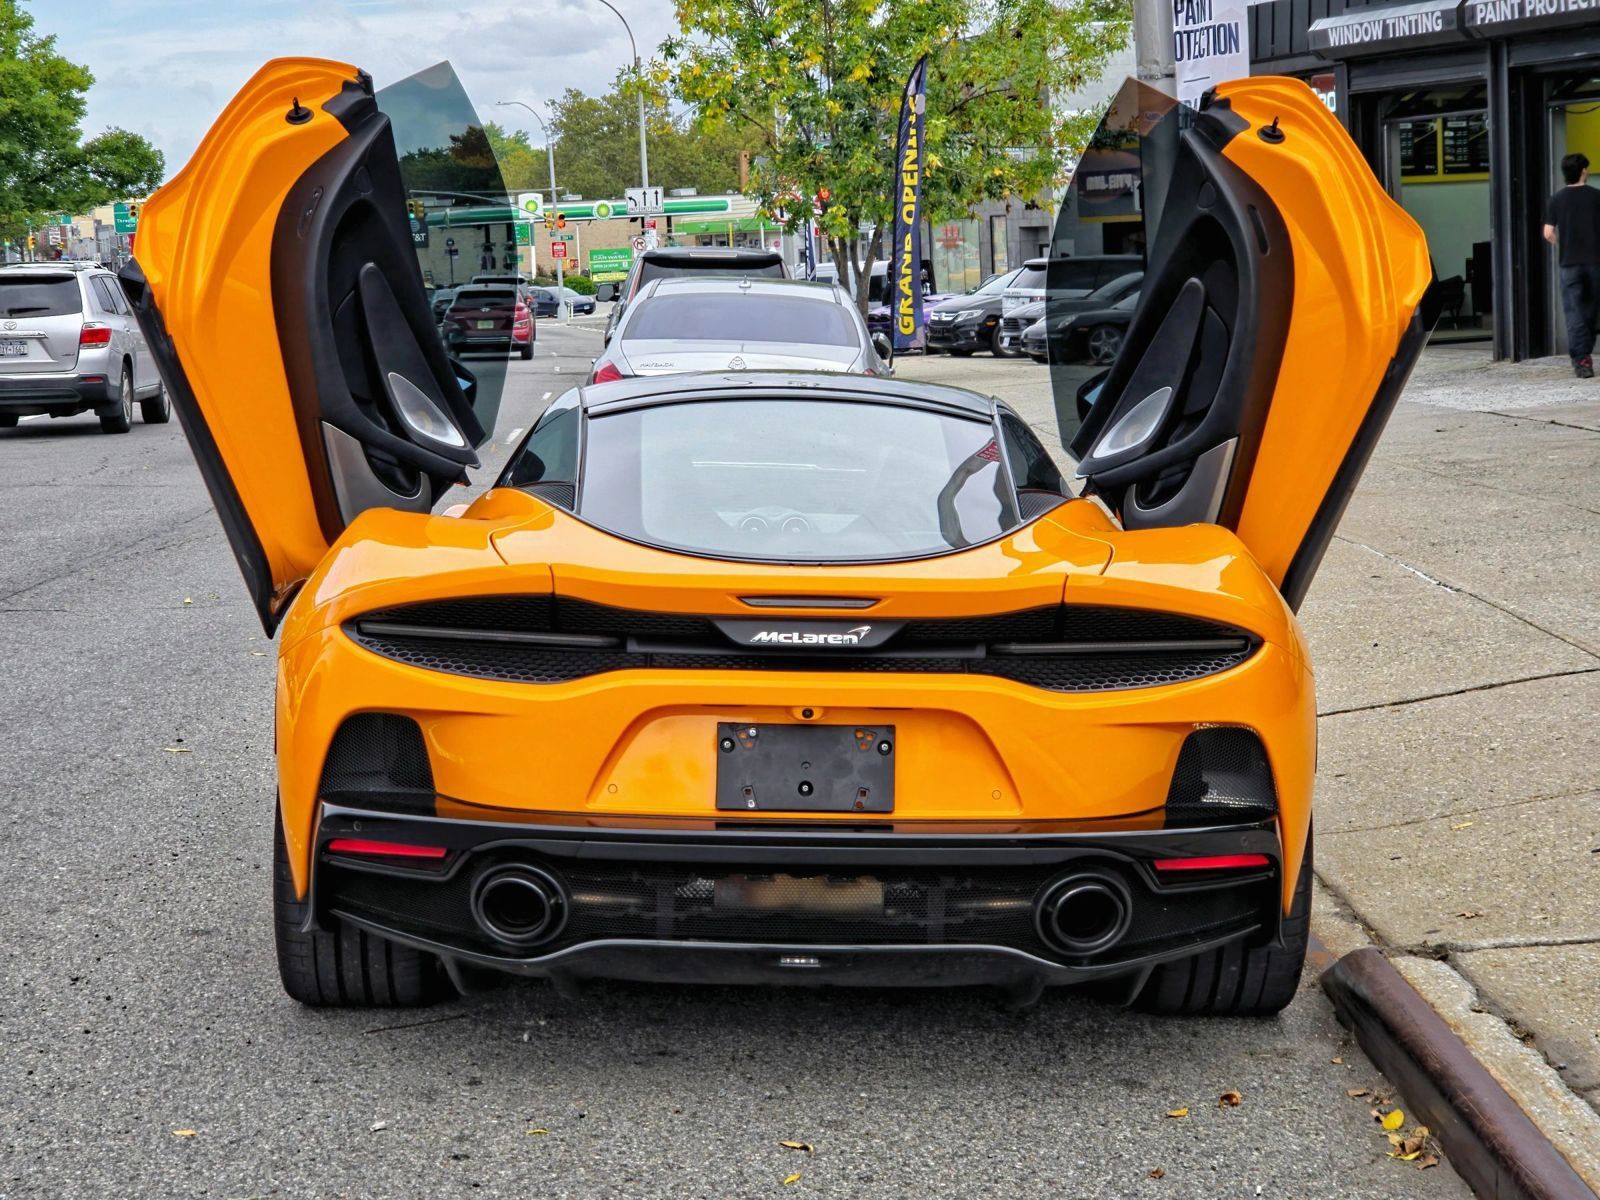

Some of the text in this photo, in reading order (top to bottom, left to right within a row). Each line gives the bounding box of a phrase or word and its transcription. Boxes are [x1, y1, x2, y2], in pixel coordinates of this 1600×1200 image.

[1477, 0, 1519, 25] PAINT
[1328, 10, 1442, 47] WINDOW TINTING
[898, 232, 915, 335] GRAND
[750, 631, 859, 645] McLaren
